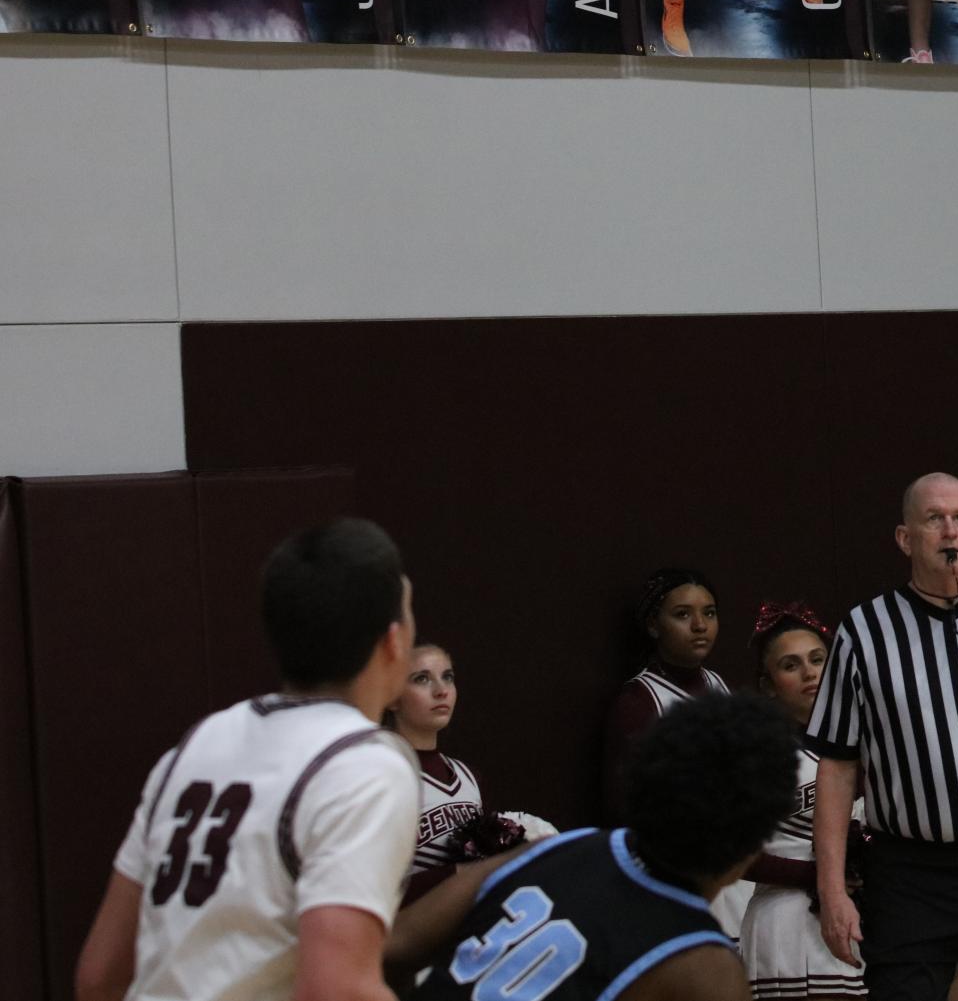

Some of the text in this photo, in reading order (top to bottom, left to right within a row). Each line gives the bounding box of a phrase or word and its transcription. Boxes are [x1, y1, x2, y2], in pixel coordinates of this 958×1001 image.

[151, 781, 253, 908] 33
[416, 802, 481, 848] CENTR
[449, 884, 588, 1001] 30
